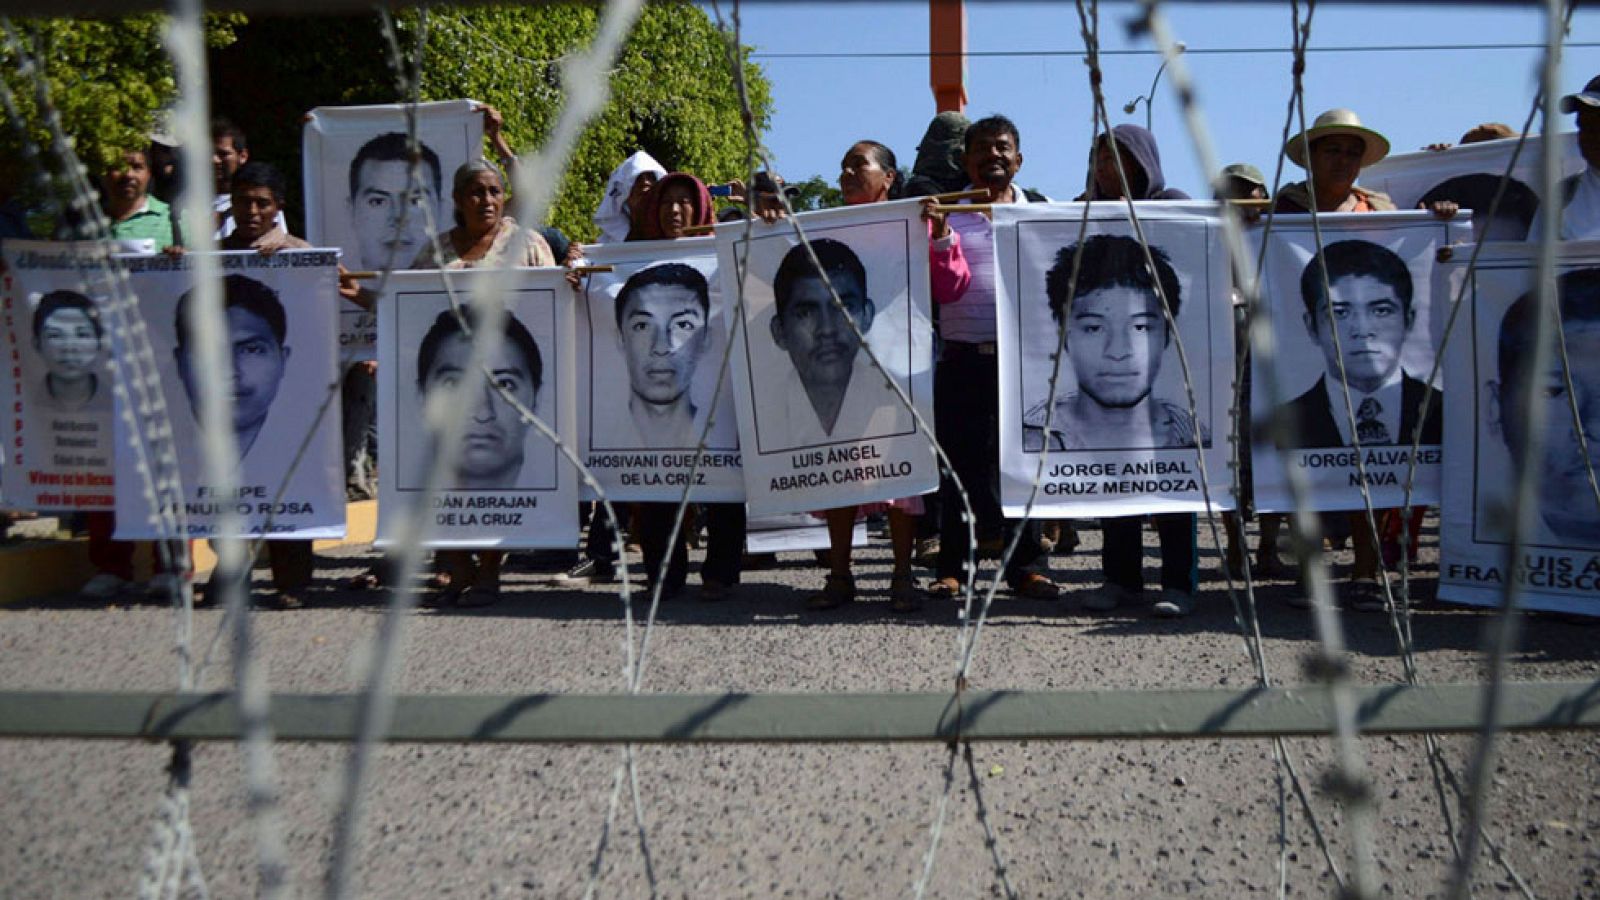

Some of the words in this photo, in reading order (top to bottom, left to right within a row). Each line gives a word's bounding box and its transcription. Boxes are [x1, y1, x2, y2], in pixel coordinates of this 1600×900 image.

[584, 455, 659, 468] JHOSIVANI
[792, 451, 824, 469] LUIS
[1050, 463, 1116, 477] JORGE
[1122, 459, 1192, 476] ANÍBAL
[1298, 452, 1358, 468] JORGE
[621, 473, 641, 486] DE
[644, 473, 663, 486] LA
[770, 471, 830, 492] ABARCA
[832, 461, 912, 484] CARRILLO
[1349, 471, 1398, 487] NAVA
[198, 486, 266, 498] FEIPE
[1044, 481, 1098, 496] CRUZ
[1103, 479, 1199, 494] MENDOZA
[159, 502, 253, 515] NULO
[258, 502, 314, 515] ROSA
[432, 494, 463, 509] DÁN
[466, 496, 537, 509] ABRAJAN
[436, 513, 457, 526] DE
[459, 513, 479, 526] LA
[482, 513, 523, 526] CRUZ
[1525, 554, 1573, 573] UIS
